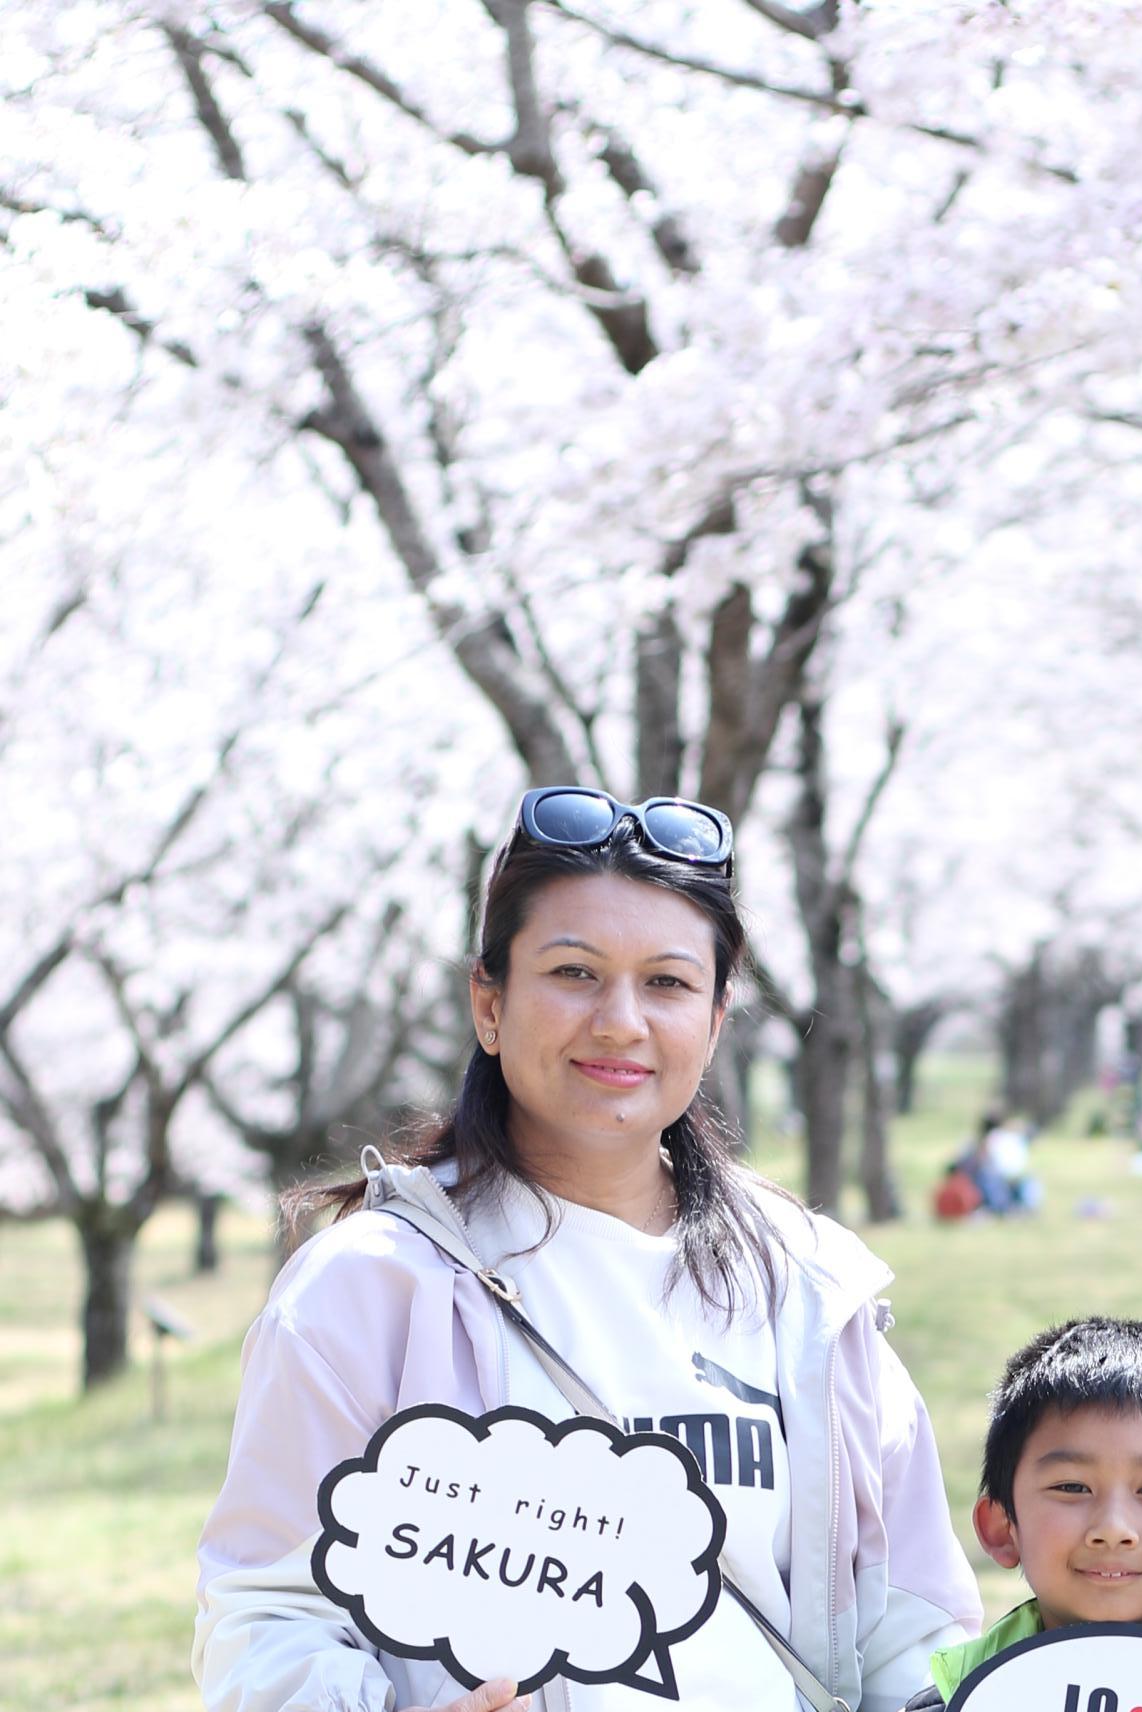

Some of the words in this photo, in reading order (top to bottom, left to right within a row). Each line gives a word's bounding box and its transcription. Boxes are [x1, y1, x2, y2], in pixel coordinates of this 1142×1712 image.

[623, 1413, 775, 1490] MA
[399, 1465, 482, 1504] Just
[514, 1498, 626, 1540] right!
[384, 1522, 605, 1609] SAKURA
